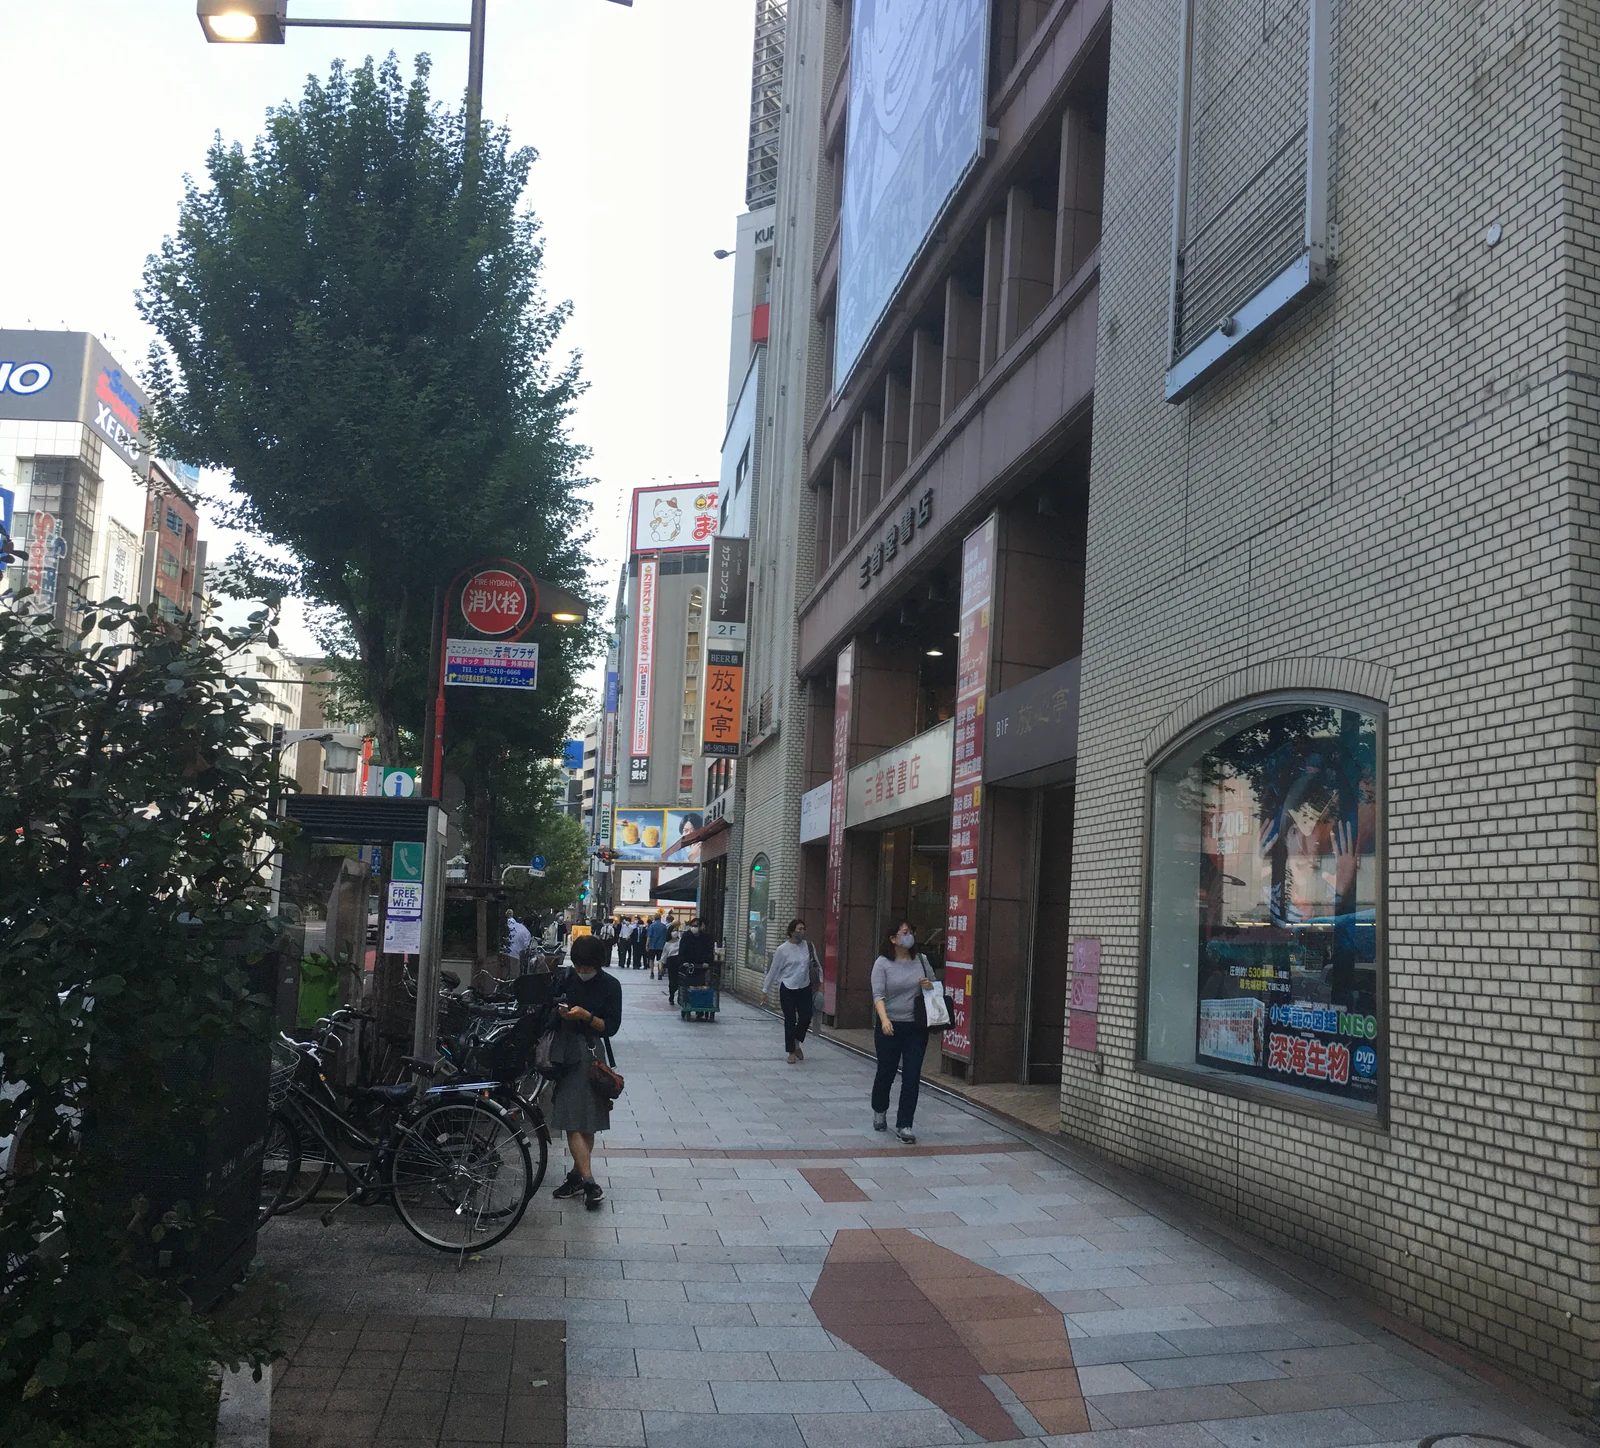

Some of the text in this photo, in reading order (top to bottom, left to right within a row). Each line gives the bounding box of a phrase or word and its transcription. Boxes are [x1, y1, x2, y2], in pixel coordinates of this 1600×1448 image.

[859, 487, 934, 590] 三省堂書店
[489, 579, 516, 588] HYDRANT
[643, 573, 653, 605] カラオケ
[719, 545, 731, 616] カフェ コンフォート
[468, 590, 521, 615] 消火栓
[718, 625, 737, 636] 2F
[710, 670, 735, 738] 放心亭
[996, 717, 1009, 737] B1F
[632, 759, 648, 769] 3F
[631, 771, 648, 781] 受付
[864, 754, 921, 806] 三省堂書店
[963, 810, 980, 828] ビジネス
[393, 889, 415, 898] FREE
[393, 899, 414, 907] Wi-Fi
[1270, 1003, 1338, 1034] 小学館の図鑑
[1339, 1012, 1377, 1039] NEO
[1268, 1032, 1350, 1085] 深海生物
[1356, 1050, 1375, 1064] DVD
[1360, 1063, 1372, 1074] つき
